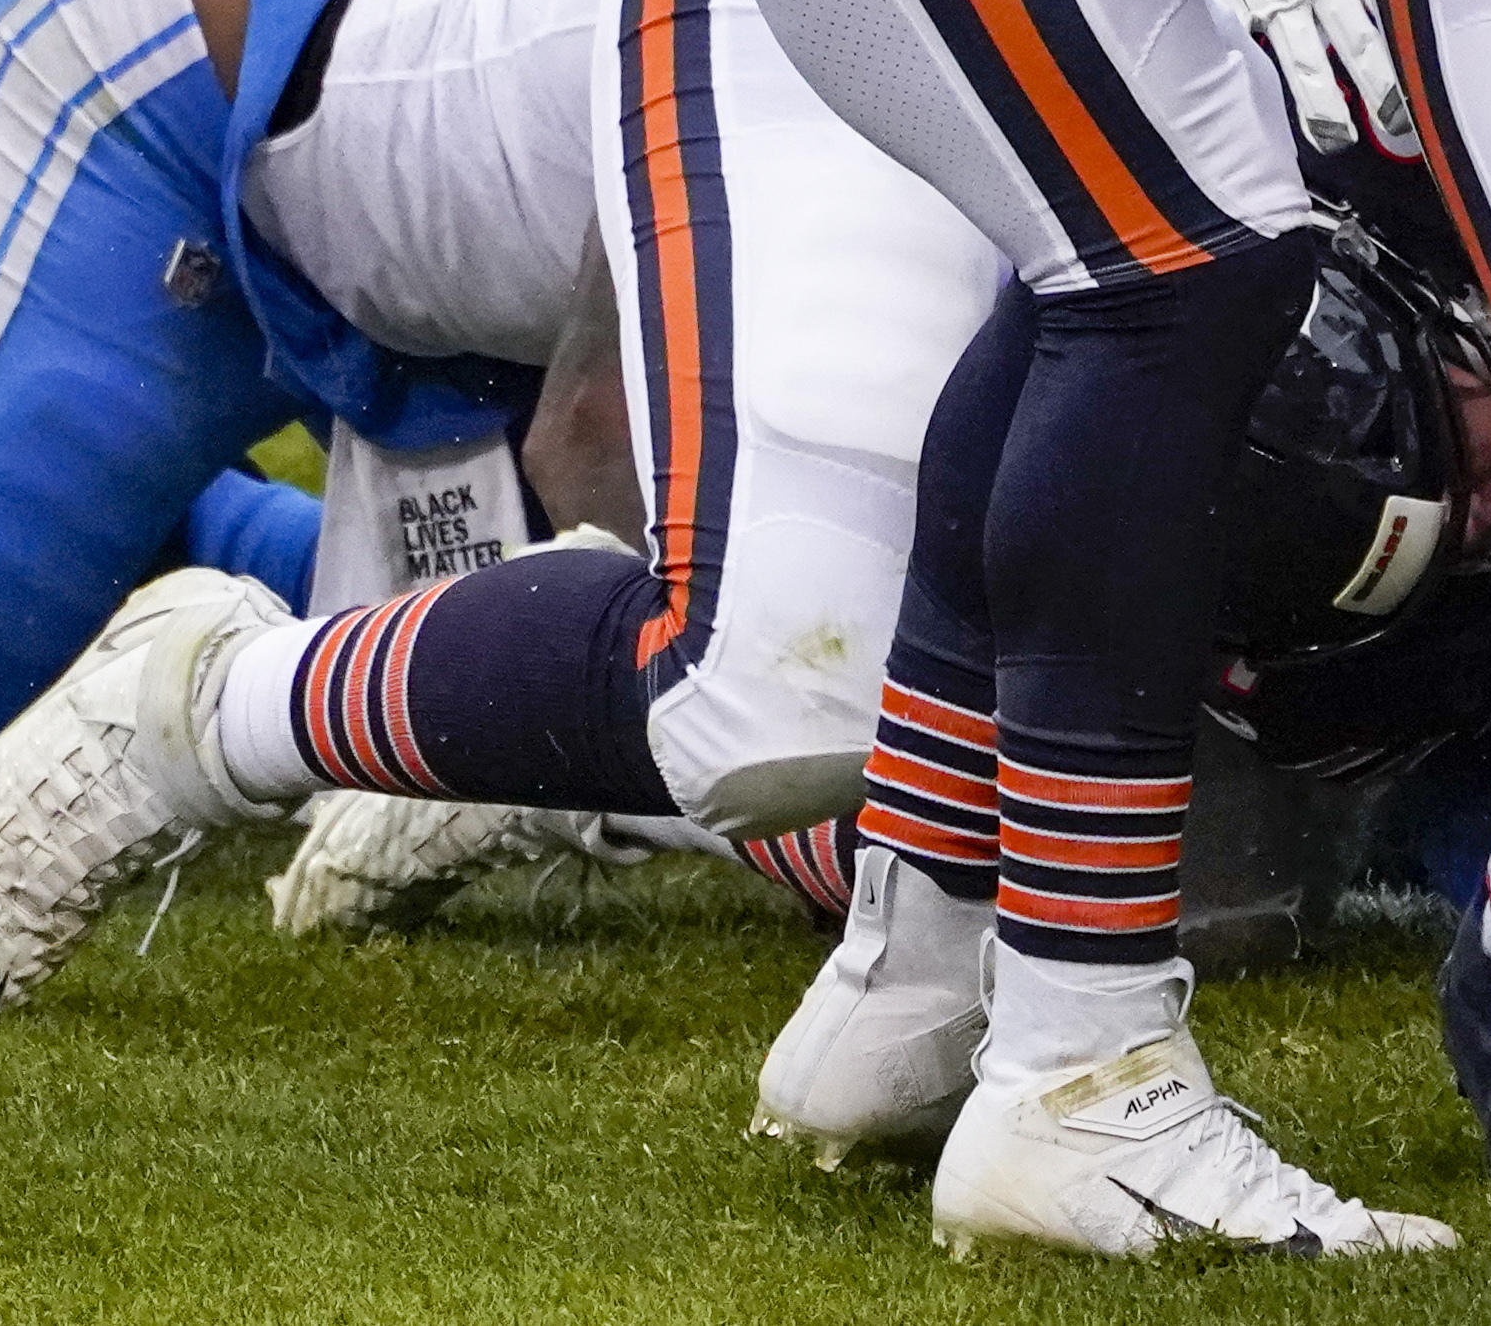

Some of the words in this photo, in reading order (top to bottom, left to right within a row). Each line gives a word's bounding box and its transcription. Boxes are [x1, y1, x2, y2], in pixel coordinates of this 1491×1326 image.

[398, 484, 478, 523] BLACK
[403, 517, 469, 551] LIVES
[406, 539, 503, 581] MATTER
[1123, 1079, 1190, 1120] ALPHA
